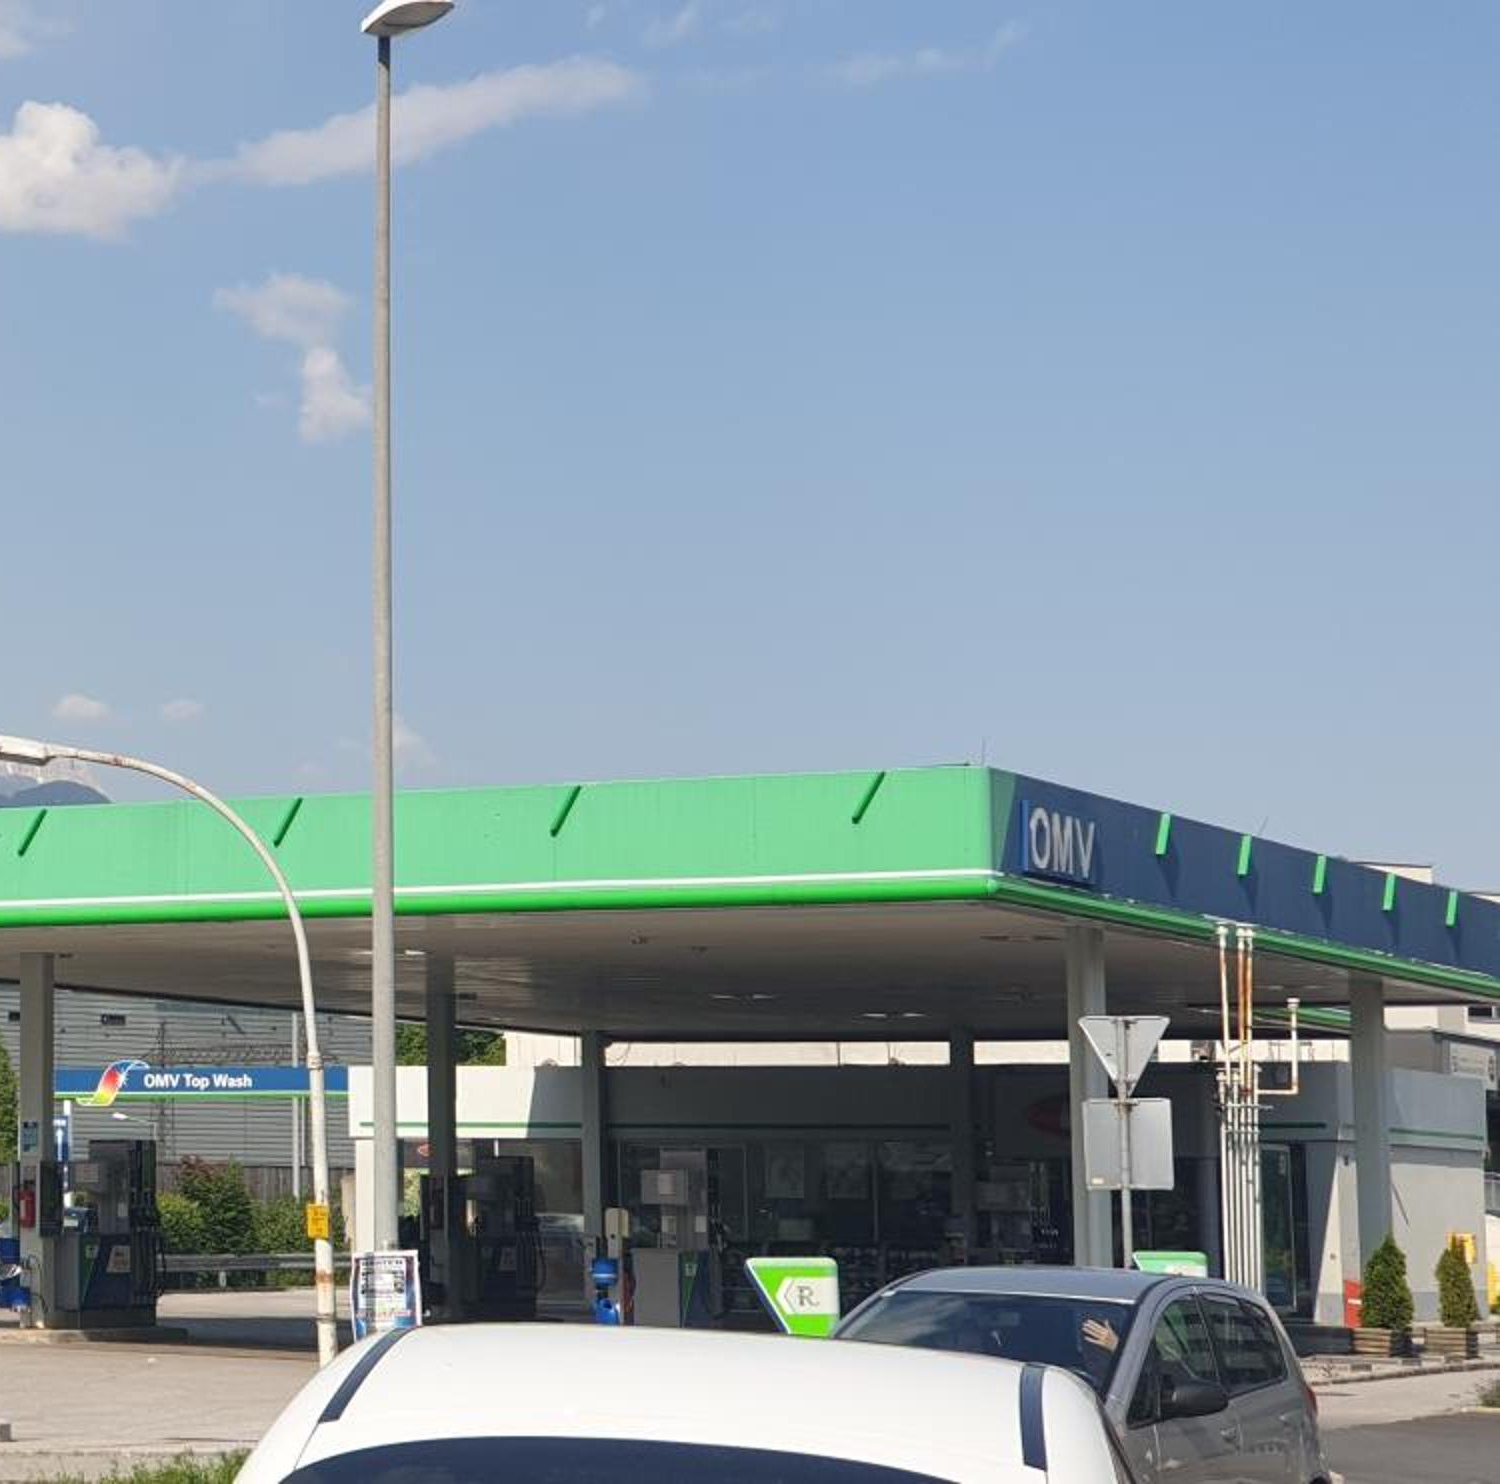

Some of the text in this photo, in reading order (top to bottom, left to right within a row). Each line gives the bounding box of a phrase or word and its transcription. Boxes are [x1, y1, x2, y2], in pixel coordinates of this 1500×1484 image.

[1029, 807, 1095, 878] OMV
[144, 1073, 252, 1090] OMV Top Wash
